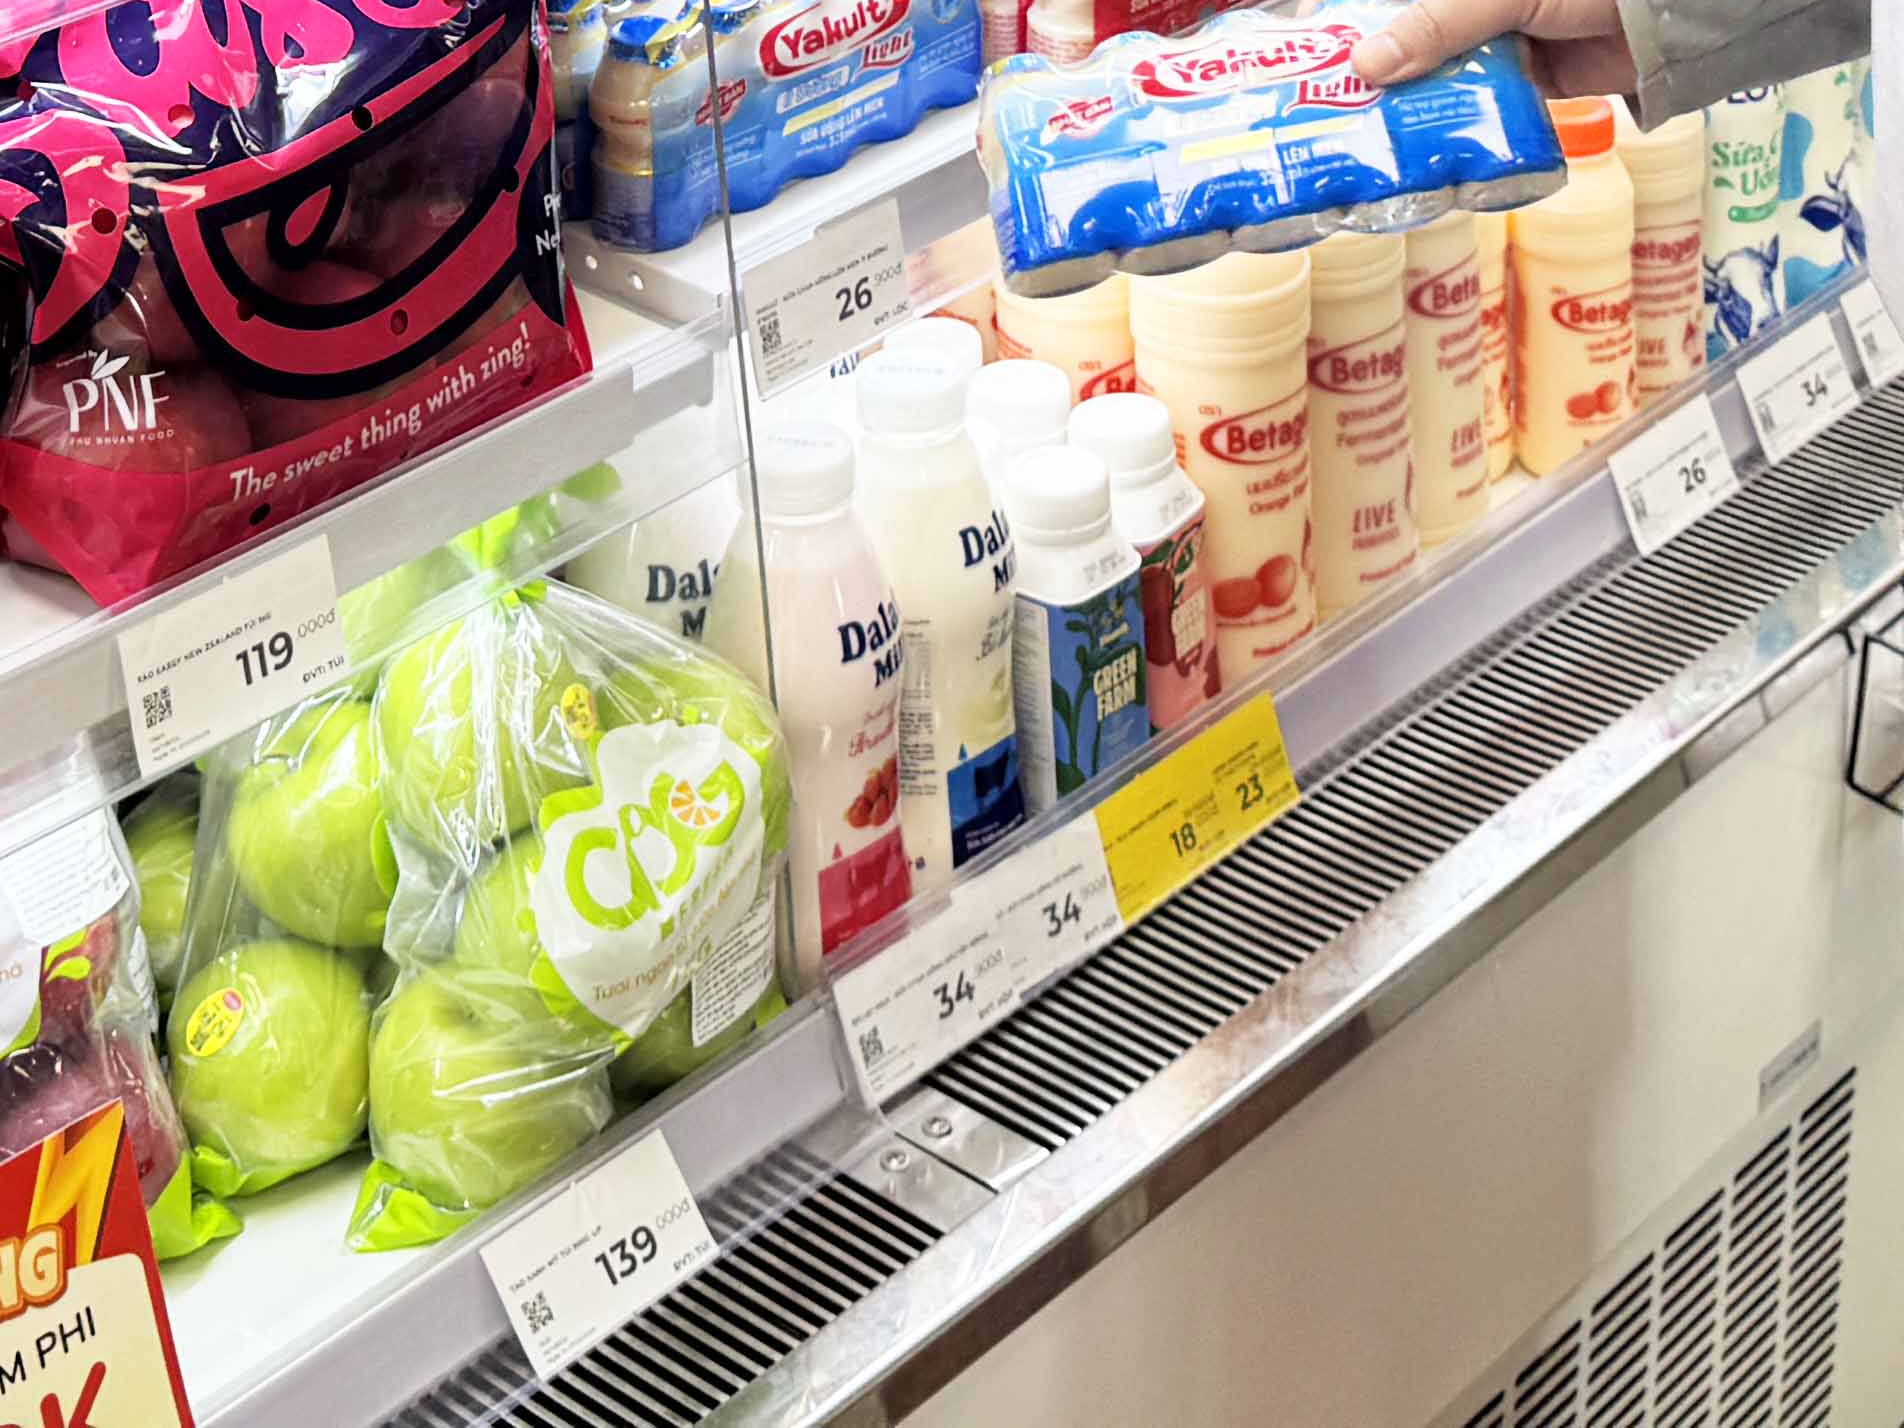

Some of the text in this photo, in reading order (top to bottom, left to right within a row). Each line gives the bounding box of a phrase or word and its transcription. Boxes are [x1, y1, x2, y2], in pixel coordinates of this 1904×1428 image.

[834, 275, 873, 322] 26
[64, 362, 167, 434] PNF
[230, 320, 534, 502] The sweet thing with zing!
[1801, 372, 1829, 407] 34
[1678, 456, 1708, 492] 26
[235, 631, 294, 687] 119
[1094, 647, 1137, 697] GREEN
[1235, 775, 1267, 811] 23
[1169, 824, 1197, 859] 18
[1042, 893, 1083, 938] 34
[933, 971, 976, 1017] 34
[594, 1224, 658, 1287] 139
[36, 1306, 97, 1371] PHI
